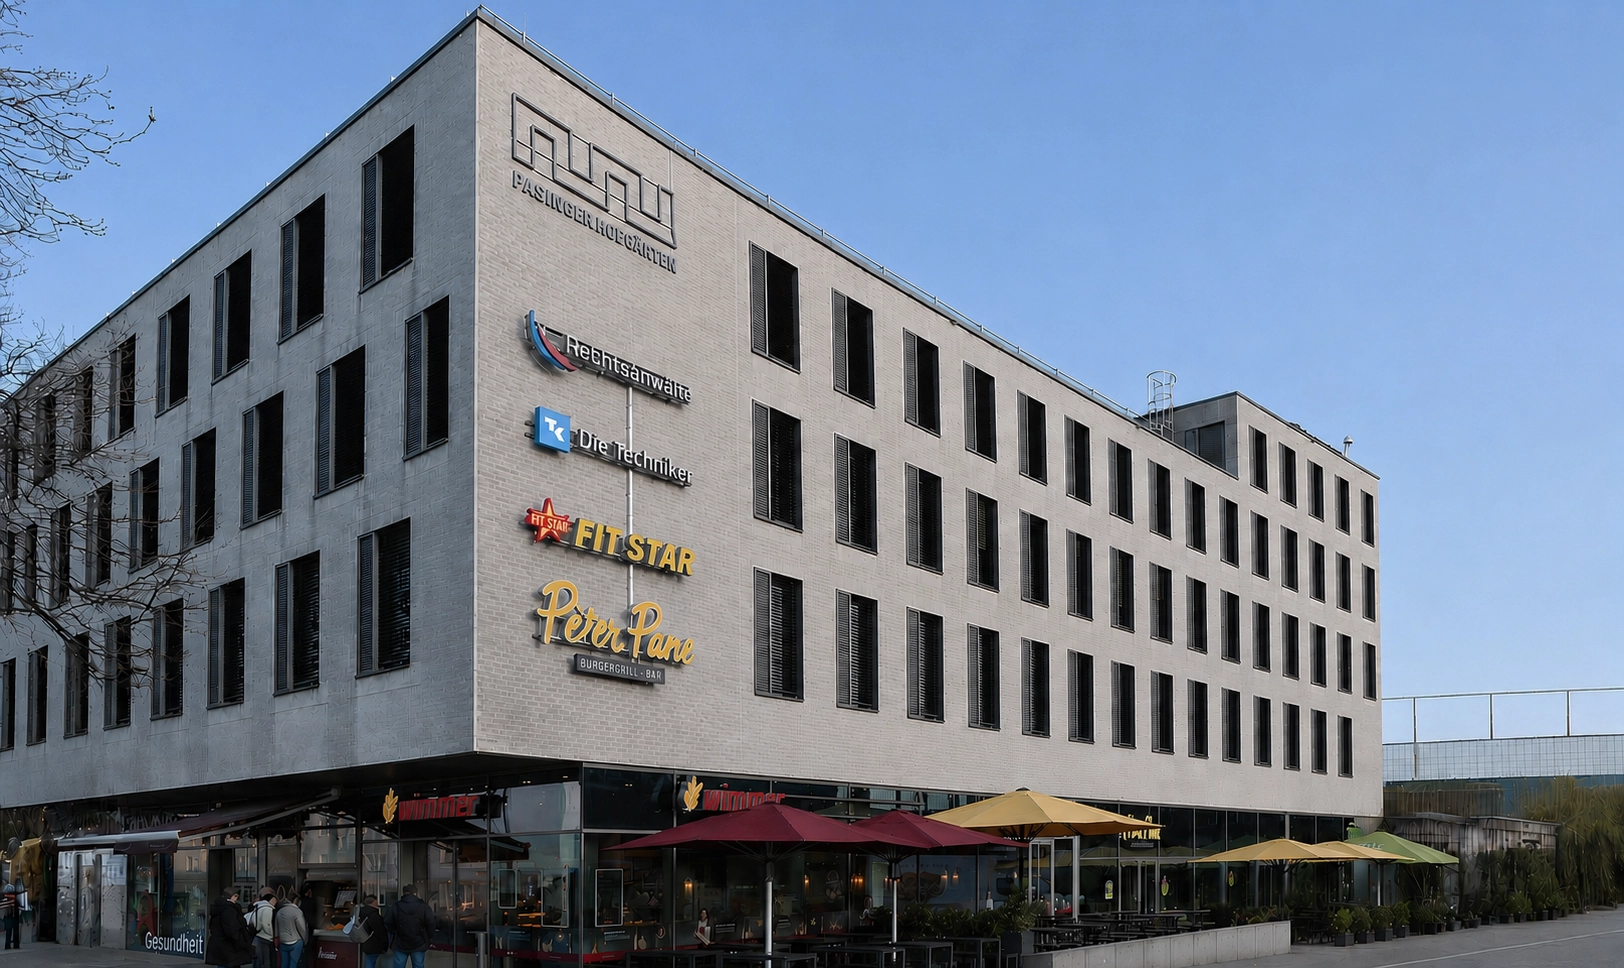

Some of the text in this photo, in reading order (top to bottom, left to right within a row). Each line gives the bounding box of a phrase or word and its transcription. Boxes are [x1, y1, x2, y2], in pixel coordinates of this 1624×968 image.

[512, 169, 595, 230] PASINGER
[566, 334, 692, 402] Rechtsanwälte
[544, 416, 565, 443] TK
[579, 429, 693, 483] Die Techniker
[531, 513, 568, 533] FIT STAR
[575, 518, 696, 576] FIT STAR
[537, 580, 695, 665] Peter Pane
[580, 657, 662, 681] BURGERGRILL BAR
[398, 793, 479, 821] wimmer
[145, 931, 203, 954] Gesundheit
